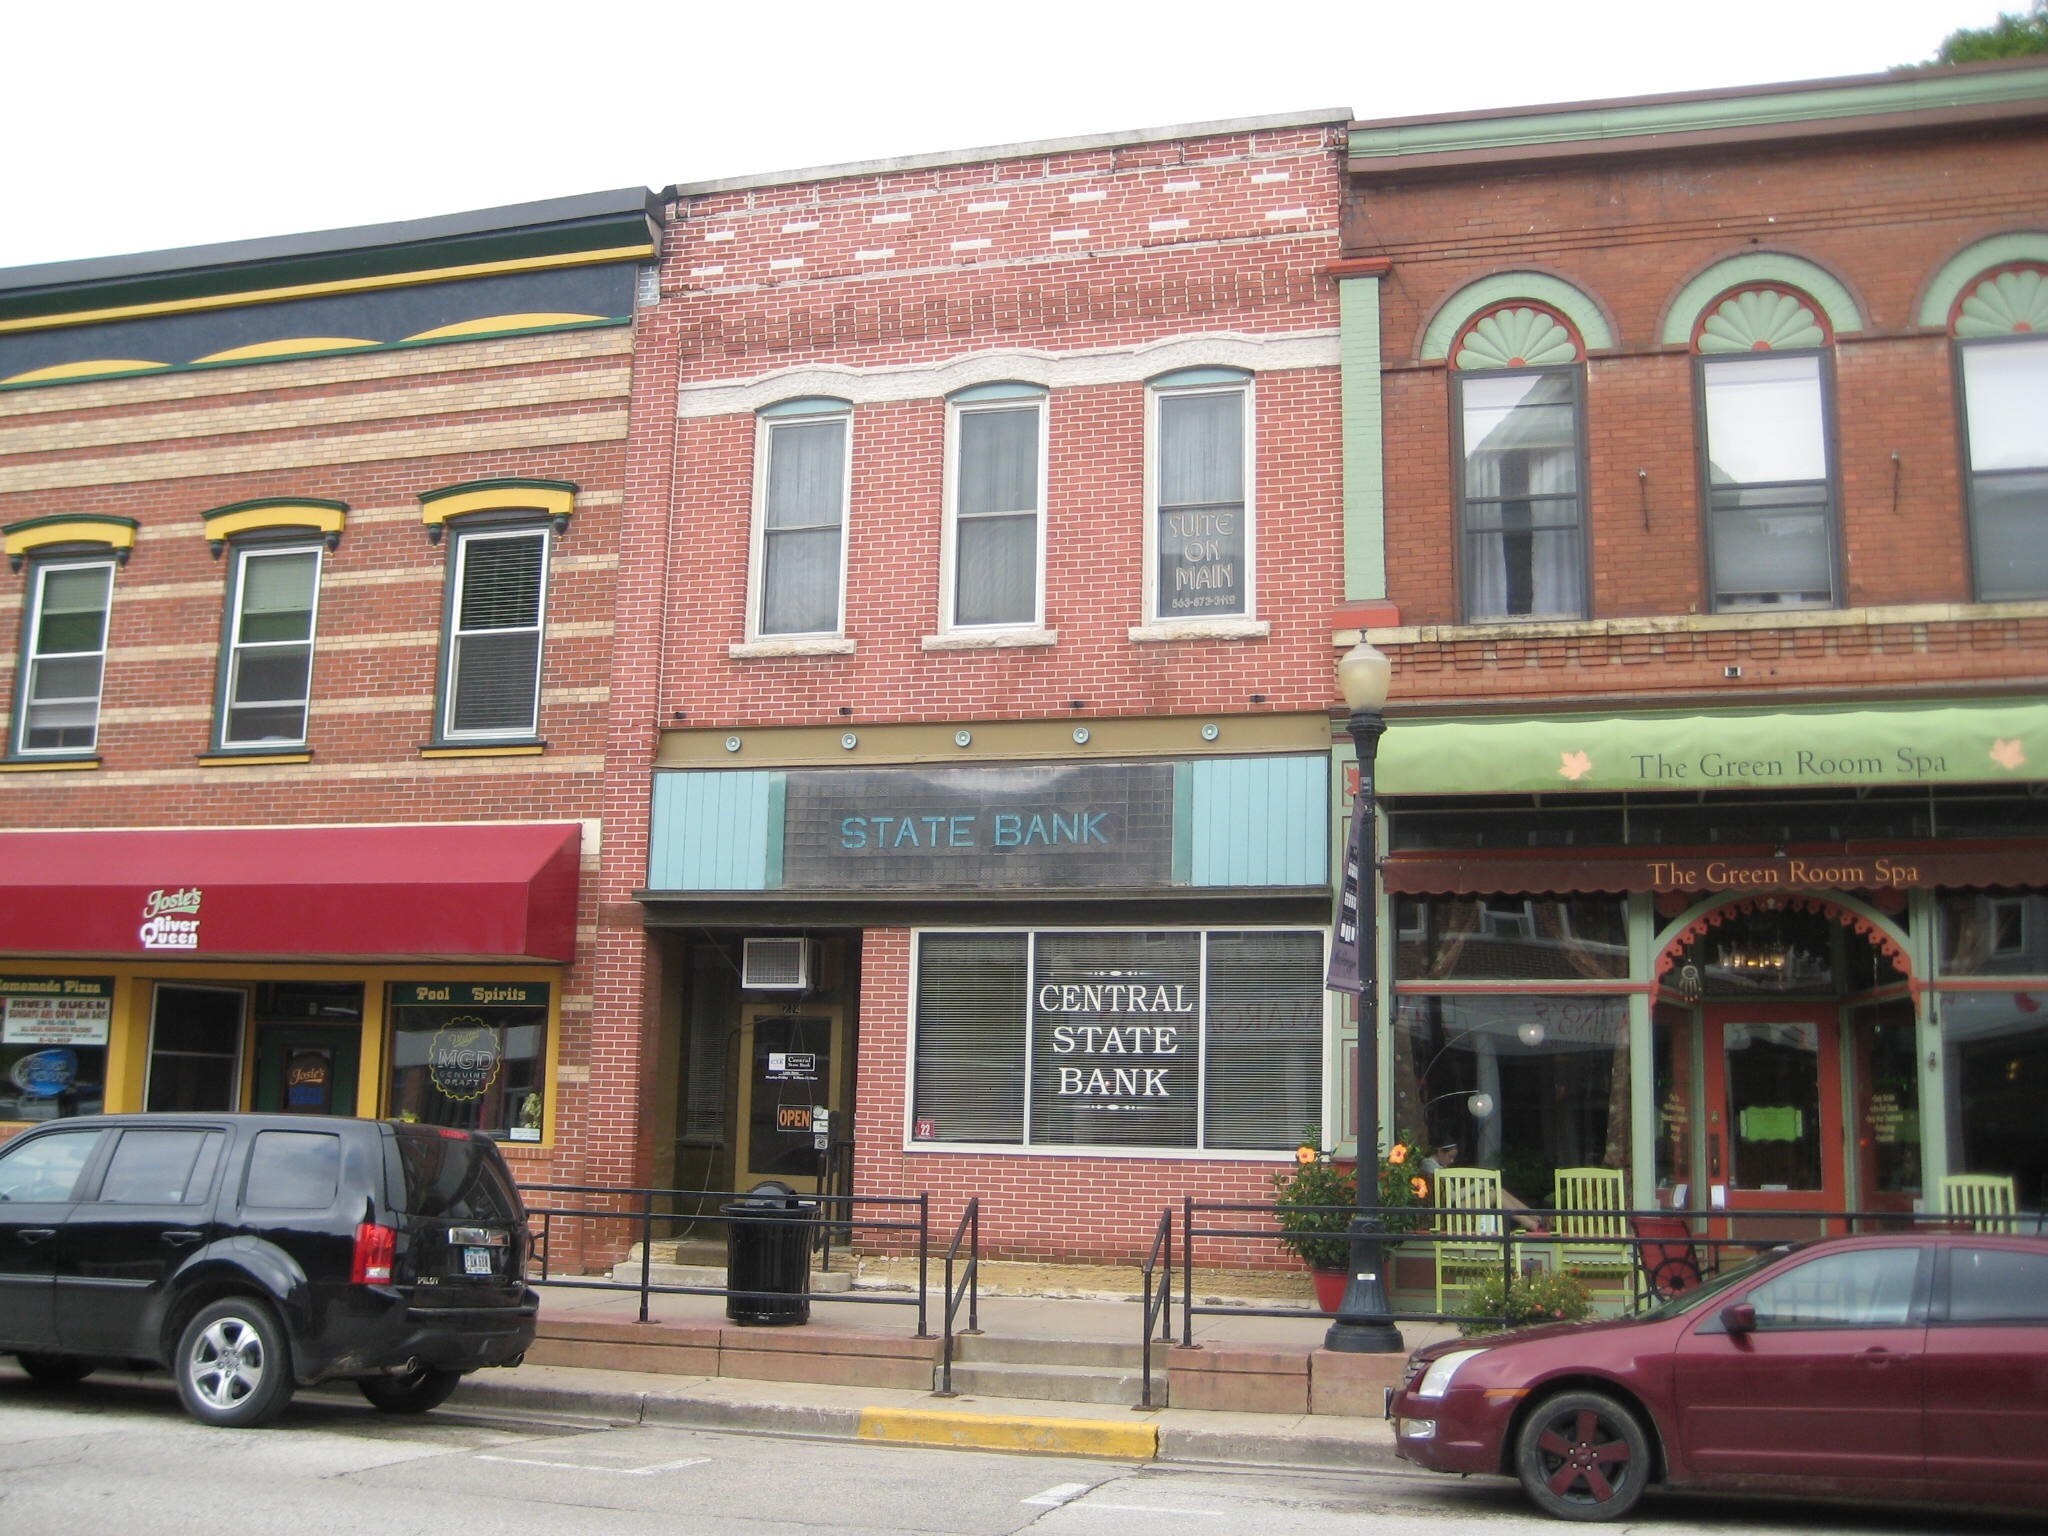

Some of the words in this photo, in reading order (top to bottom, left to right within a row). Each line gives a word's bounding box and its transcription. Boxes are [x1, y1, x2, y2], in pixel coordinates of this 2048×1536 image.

[1169, 512, 1233, 538] SUITE
[1184, 540, 1220, 562] ON
[1175, 563, 1233, 591] MAIN
[1631, 754, 1687, 779] The
[1699, 752, 1783, 778] Green
[1796, 749, 1883, 775] Room
[1896, 747, 1946, 777] Spa
[840, 815, 976, 849] STATE
[992, 812, 1109, 847] BANK
[1648, 862, 1697, 885] The
[1706, 861, 1778, 885] Green
[1789, 859, 1864, 883] Room
[1875, 858, 1917, 886] Spa
[143, 887, 202, 918] Josie's
[140, 922, 199, 948] Queen
[154, 915, 200, 932] River
[64, 980, 101, 993] Pizza
[416, 986, 450, 1000] Pool
[471, 987, 526, 1003] Spirits
[1039, 985, 1193, 1012] CENTRAL
[12, 1001, 52, 1009] RIVER
[1053, 1026, 1178, 1054] STATE
[437, 1049, 494, 1071] MGD
[438, 1071, 487, 1079] GENUINE
[1058, 1068, 1170, 1096] BANK
[779, 1109, 810, 1127] OPEN
[920, 1124, 930, 1136] 22
